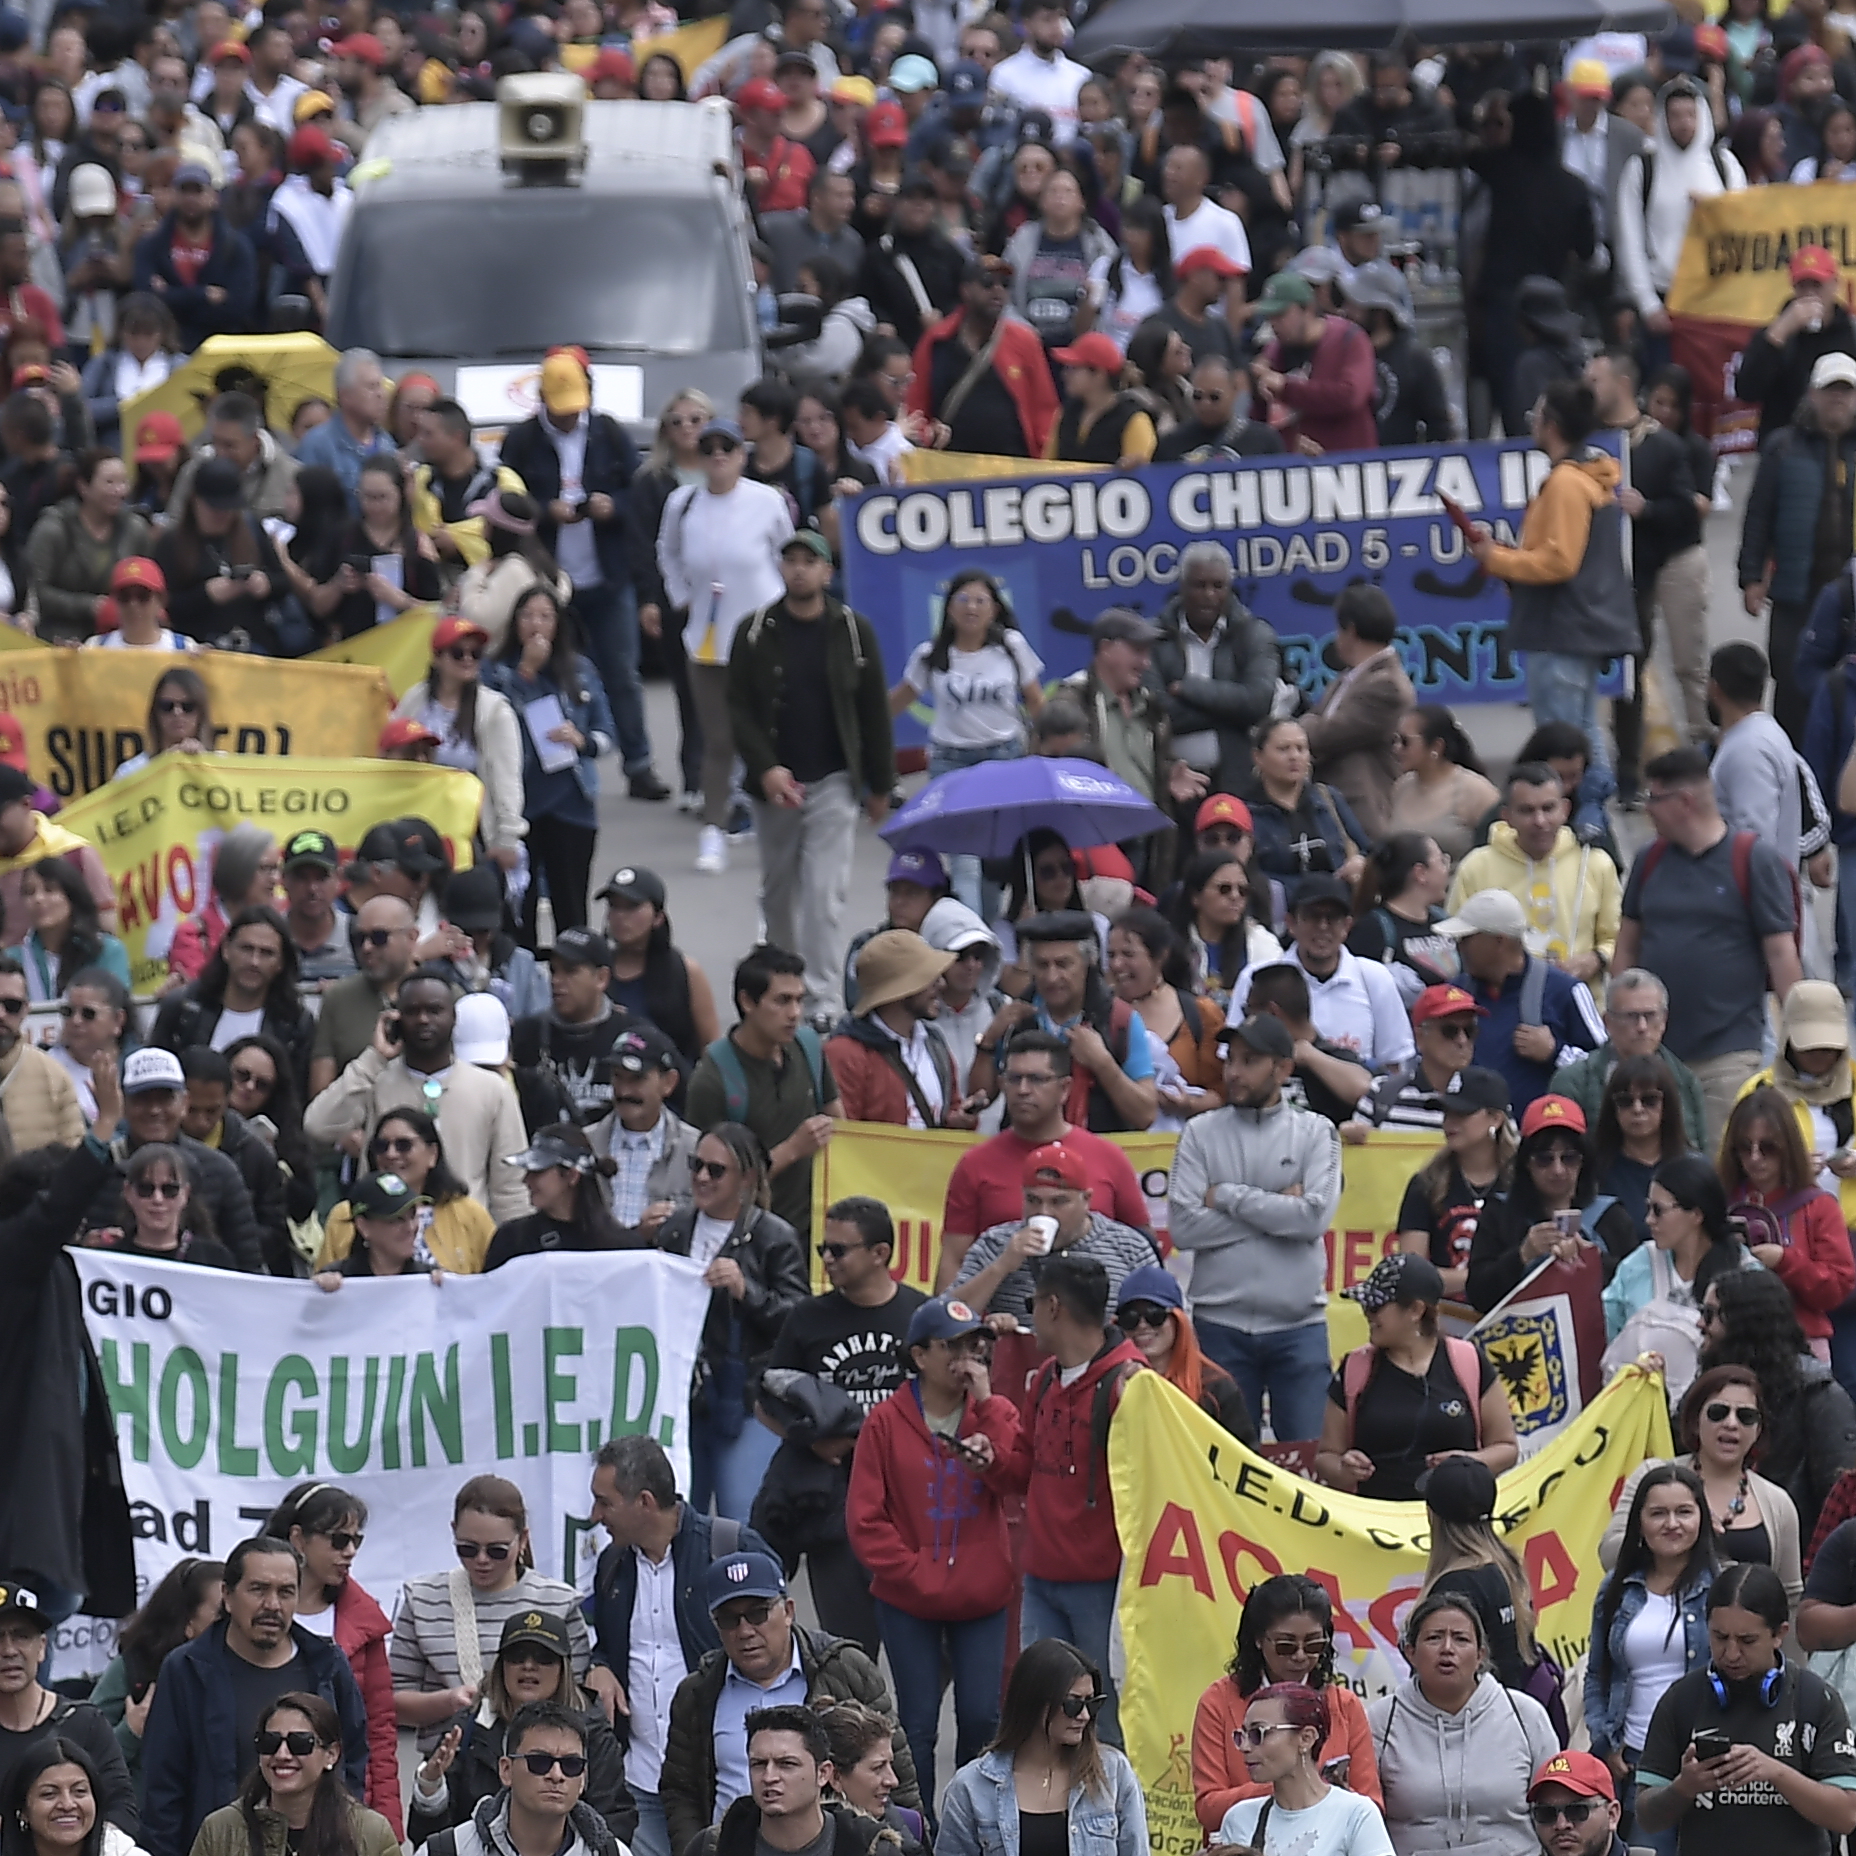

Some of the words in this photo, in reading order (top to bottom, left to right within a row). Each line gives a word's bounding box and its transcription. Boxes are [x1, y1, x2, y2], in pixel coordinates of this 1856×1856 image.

[856, 475, 1151, 556] COLEGIO
[1169, 454, 1484, 535] CHUNIZA
[1361, 529, 1389, 571] 5
[178, 782, 350, 815] COLEGIO
[100, 1338, 464, 1479] HOLGUIN
[490, 1326, 676, 1461] I.E.D.
[1207, 1442, 1345, 1539] I.E.D.
